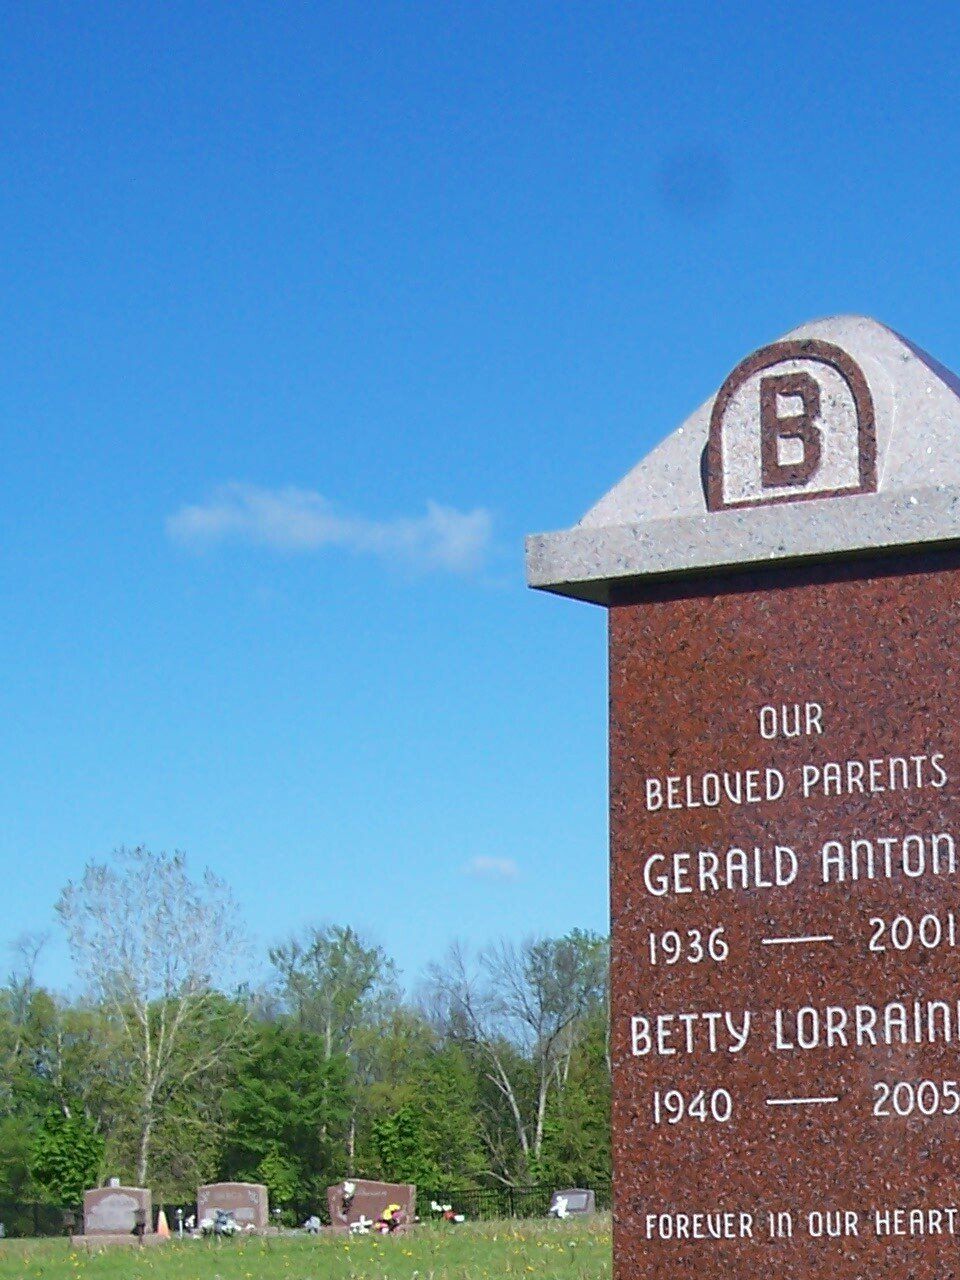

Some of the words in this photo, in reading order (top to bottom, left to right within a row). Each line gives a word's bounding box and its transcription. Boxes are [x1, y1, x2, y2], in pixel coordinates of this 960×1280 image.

[760, 372, 823, 488] B
[759, 702, 823, 739] OUR
[645, 768, 784, 812] BELOVED
[801, 753, 948, 798] PARENTS
[643, 845, 799, 896] GERALD
[821, 831, 956, 883] ANTON
[649, 927, 730, 965] 1936
[868, 913, 956, 952] 2001
[630, 1009, 751, 1056] BETTY
[652, 1087, 733, 1124] 1940
[872, 1080, 960, 1117] 2005
[645, 1212, 754, 1240] FOREVER
[769, 1211, 793, 1238] IN
[808, 1211, 858, 1237] OUR
